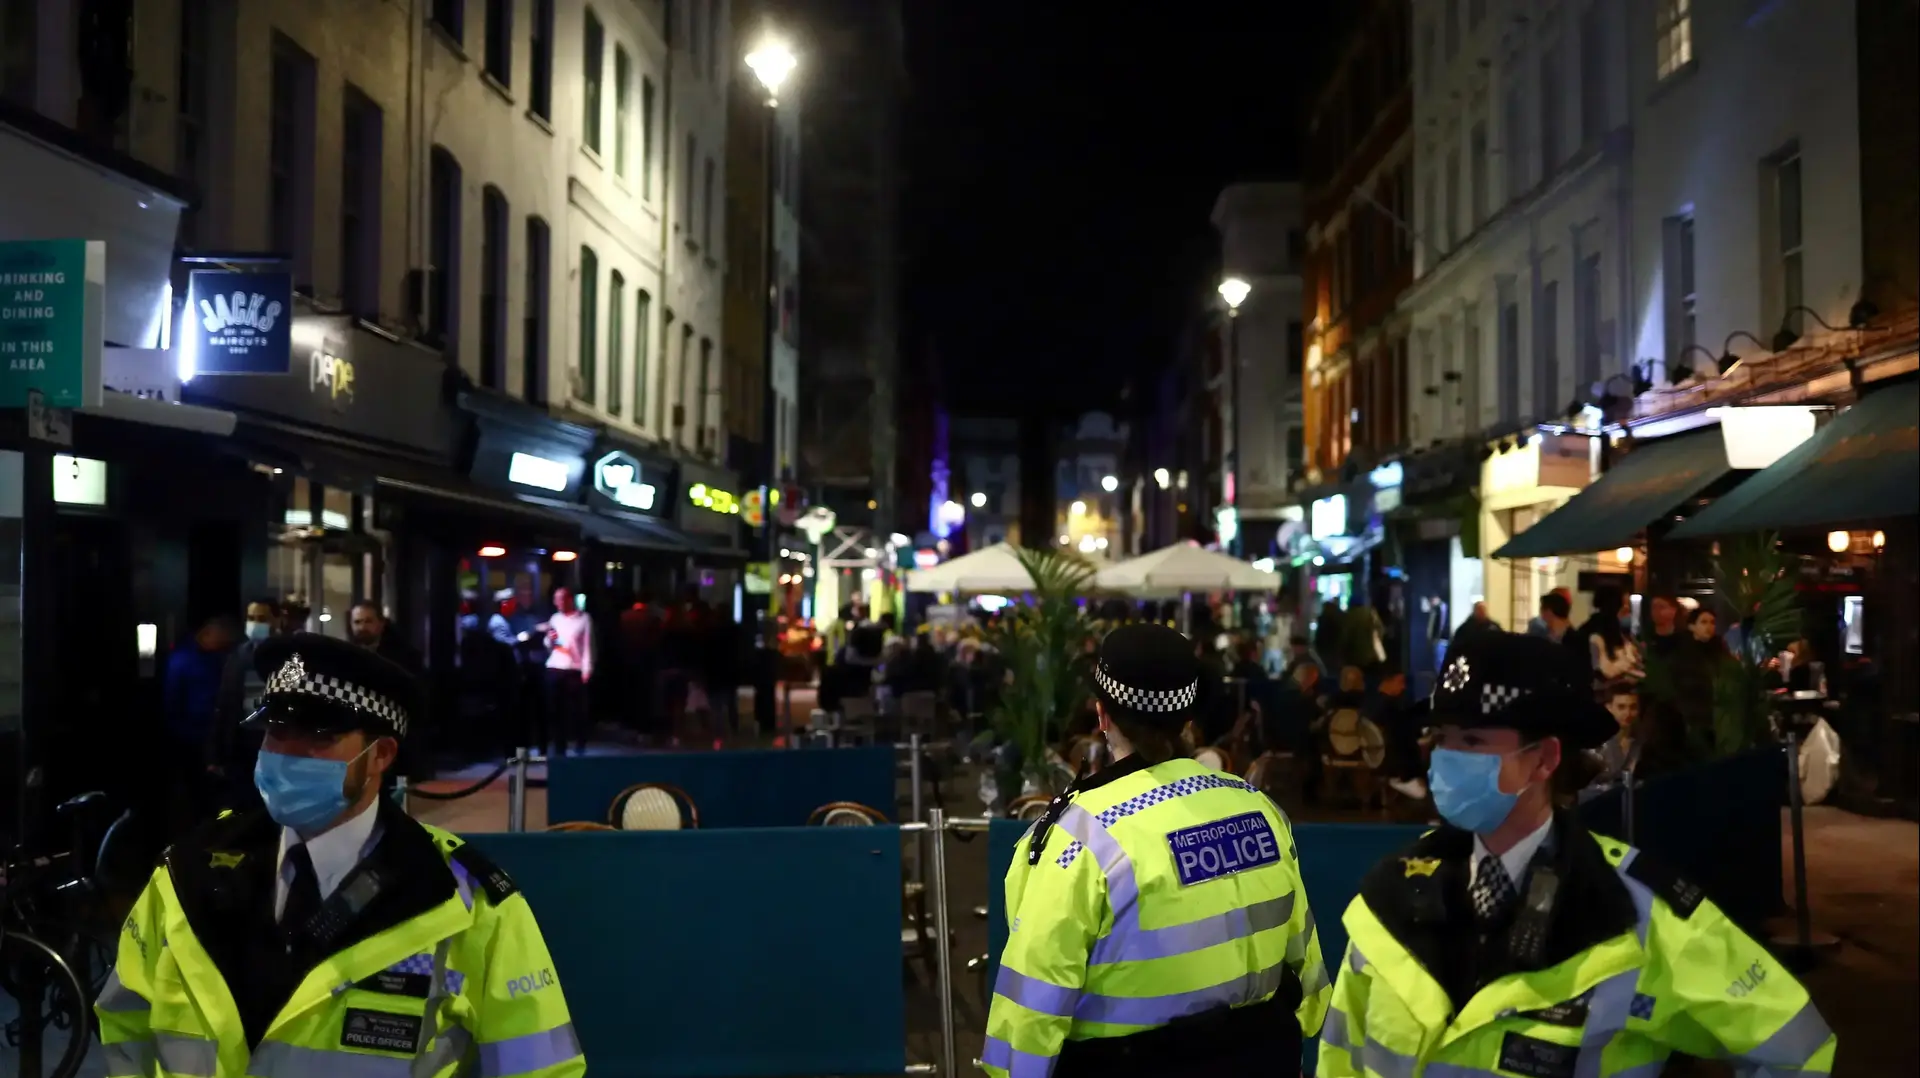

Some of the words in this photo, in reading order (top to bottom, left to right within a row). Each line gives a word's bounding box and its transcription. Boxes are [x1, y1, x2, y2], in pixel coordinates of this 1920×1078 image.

[14, 290, 44, 302] AND
[2, 306, 55, 319] DINING
[200, 290, 282, 332] JACKS
[1, 341, 16, 353] IN
[21, 340, 54, 353] THIS
[209, 336, 267, 346] HAIRCUTS
[9, 358, 45, 370] AREA
[1173, 816, 1267, 849] METROPOLITAN
[1179, 831, 1276, 879] POLICE
[507, 967, 554, 999] POLIC
[373, 1025, 407, 1035] POLICE
[345, 1033, 378, 1044] POLICE
